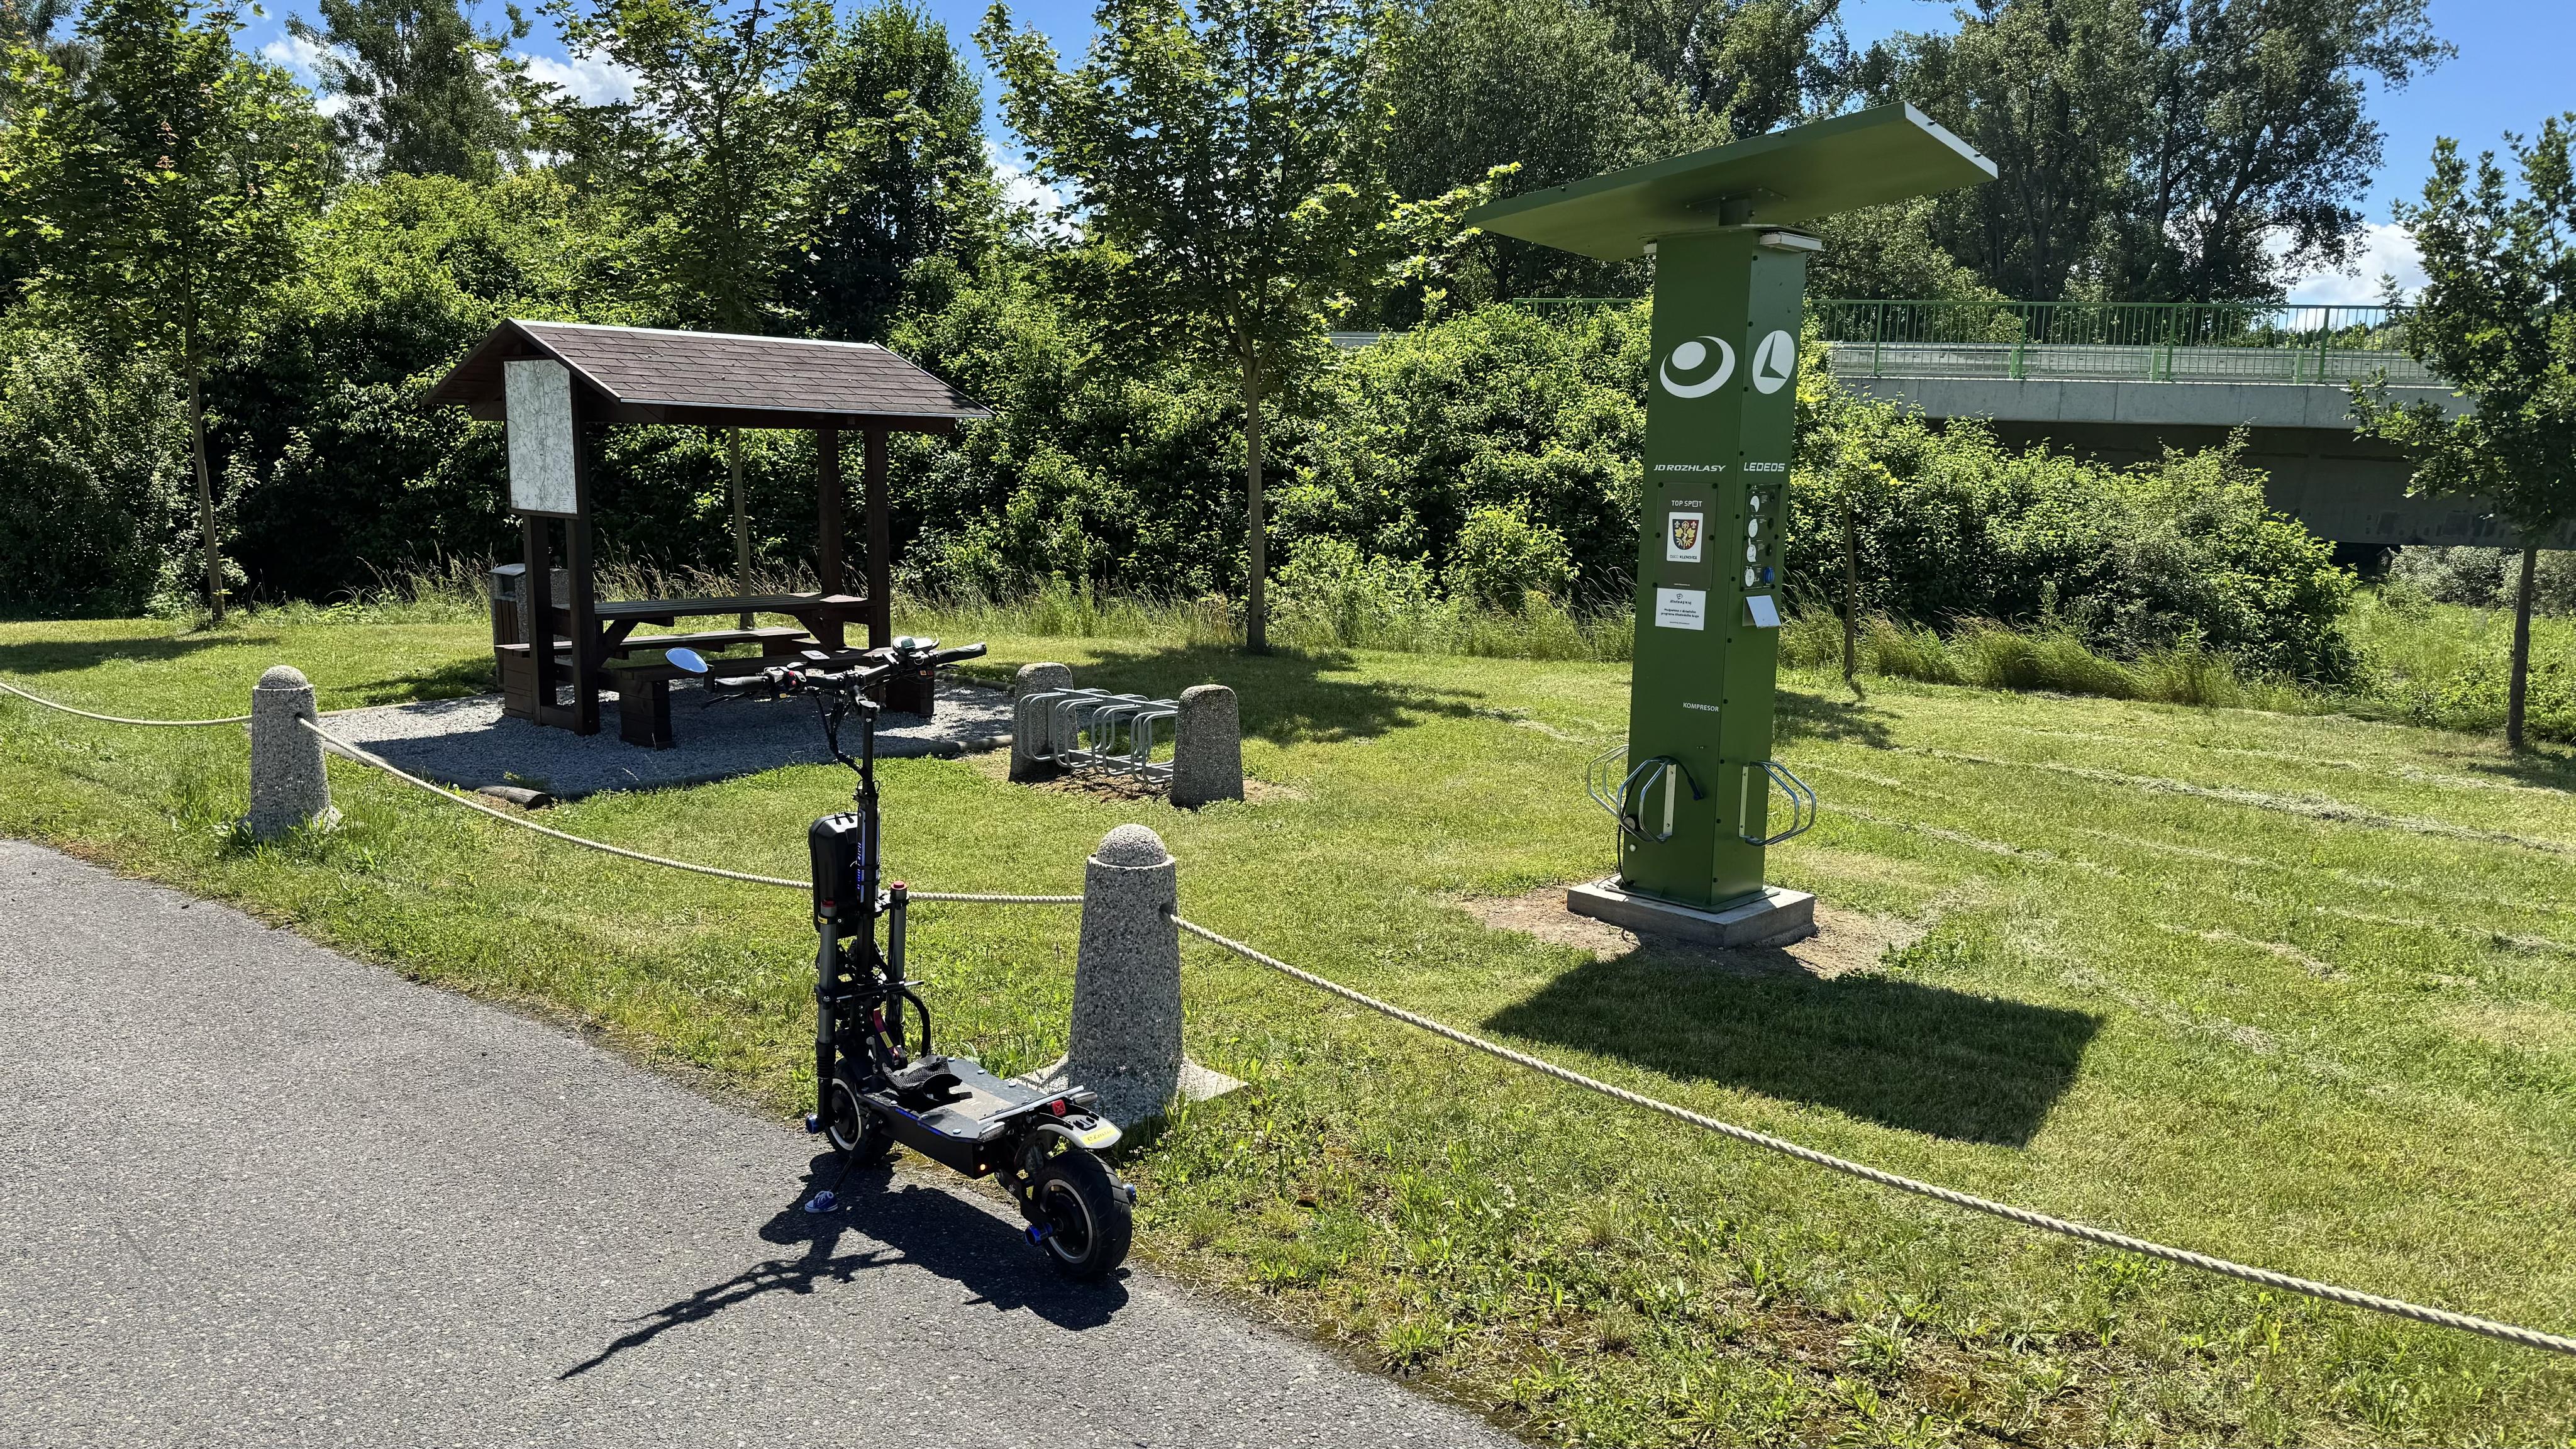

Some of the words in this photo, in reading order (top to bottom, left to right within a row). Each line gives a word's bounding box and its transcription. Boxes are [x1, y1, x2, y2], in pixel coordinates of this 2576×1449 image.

[1667, 464, 1726, 472] ROZHLASY
[1743, 462, 1785, 472] LEDEOS
[1683, 702, 1719, 712] KOMPRESOR
